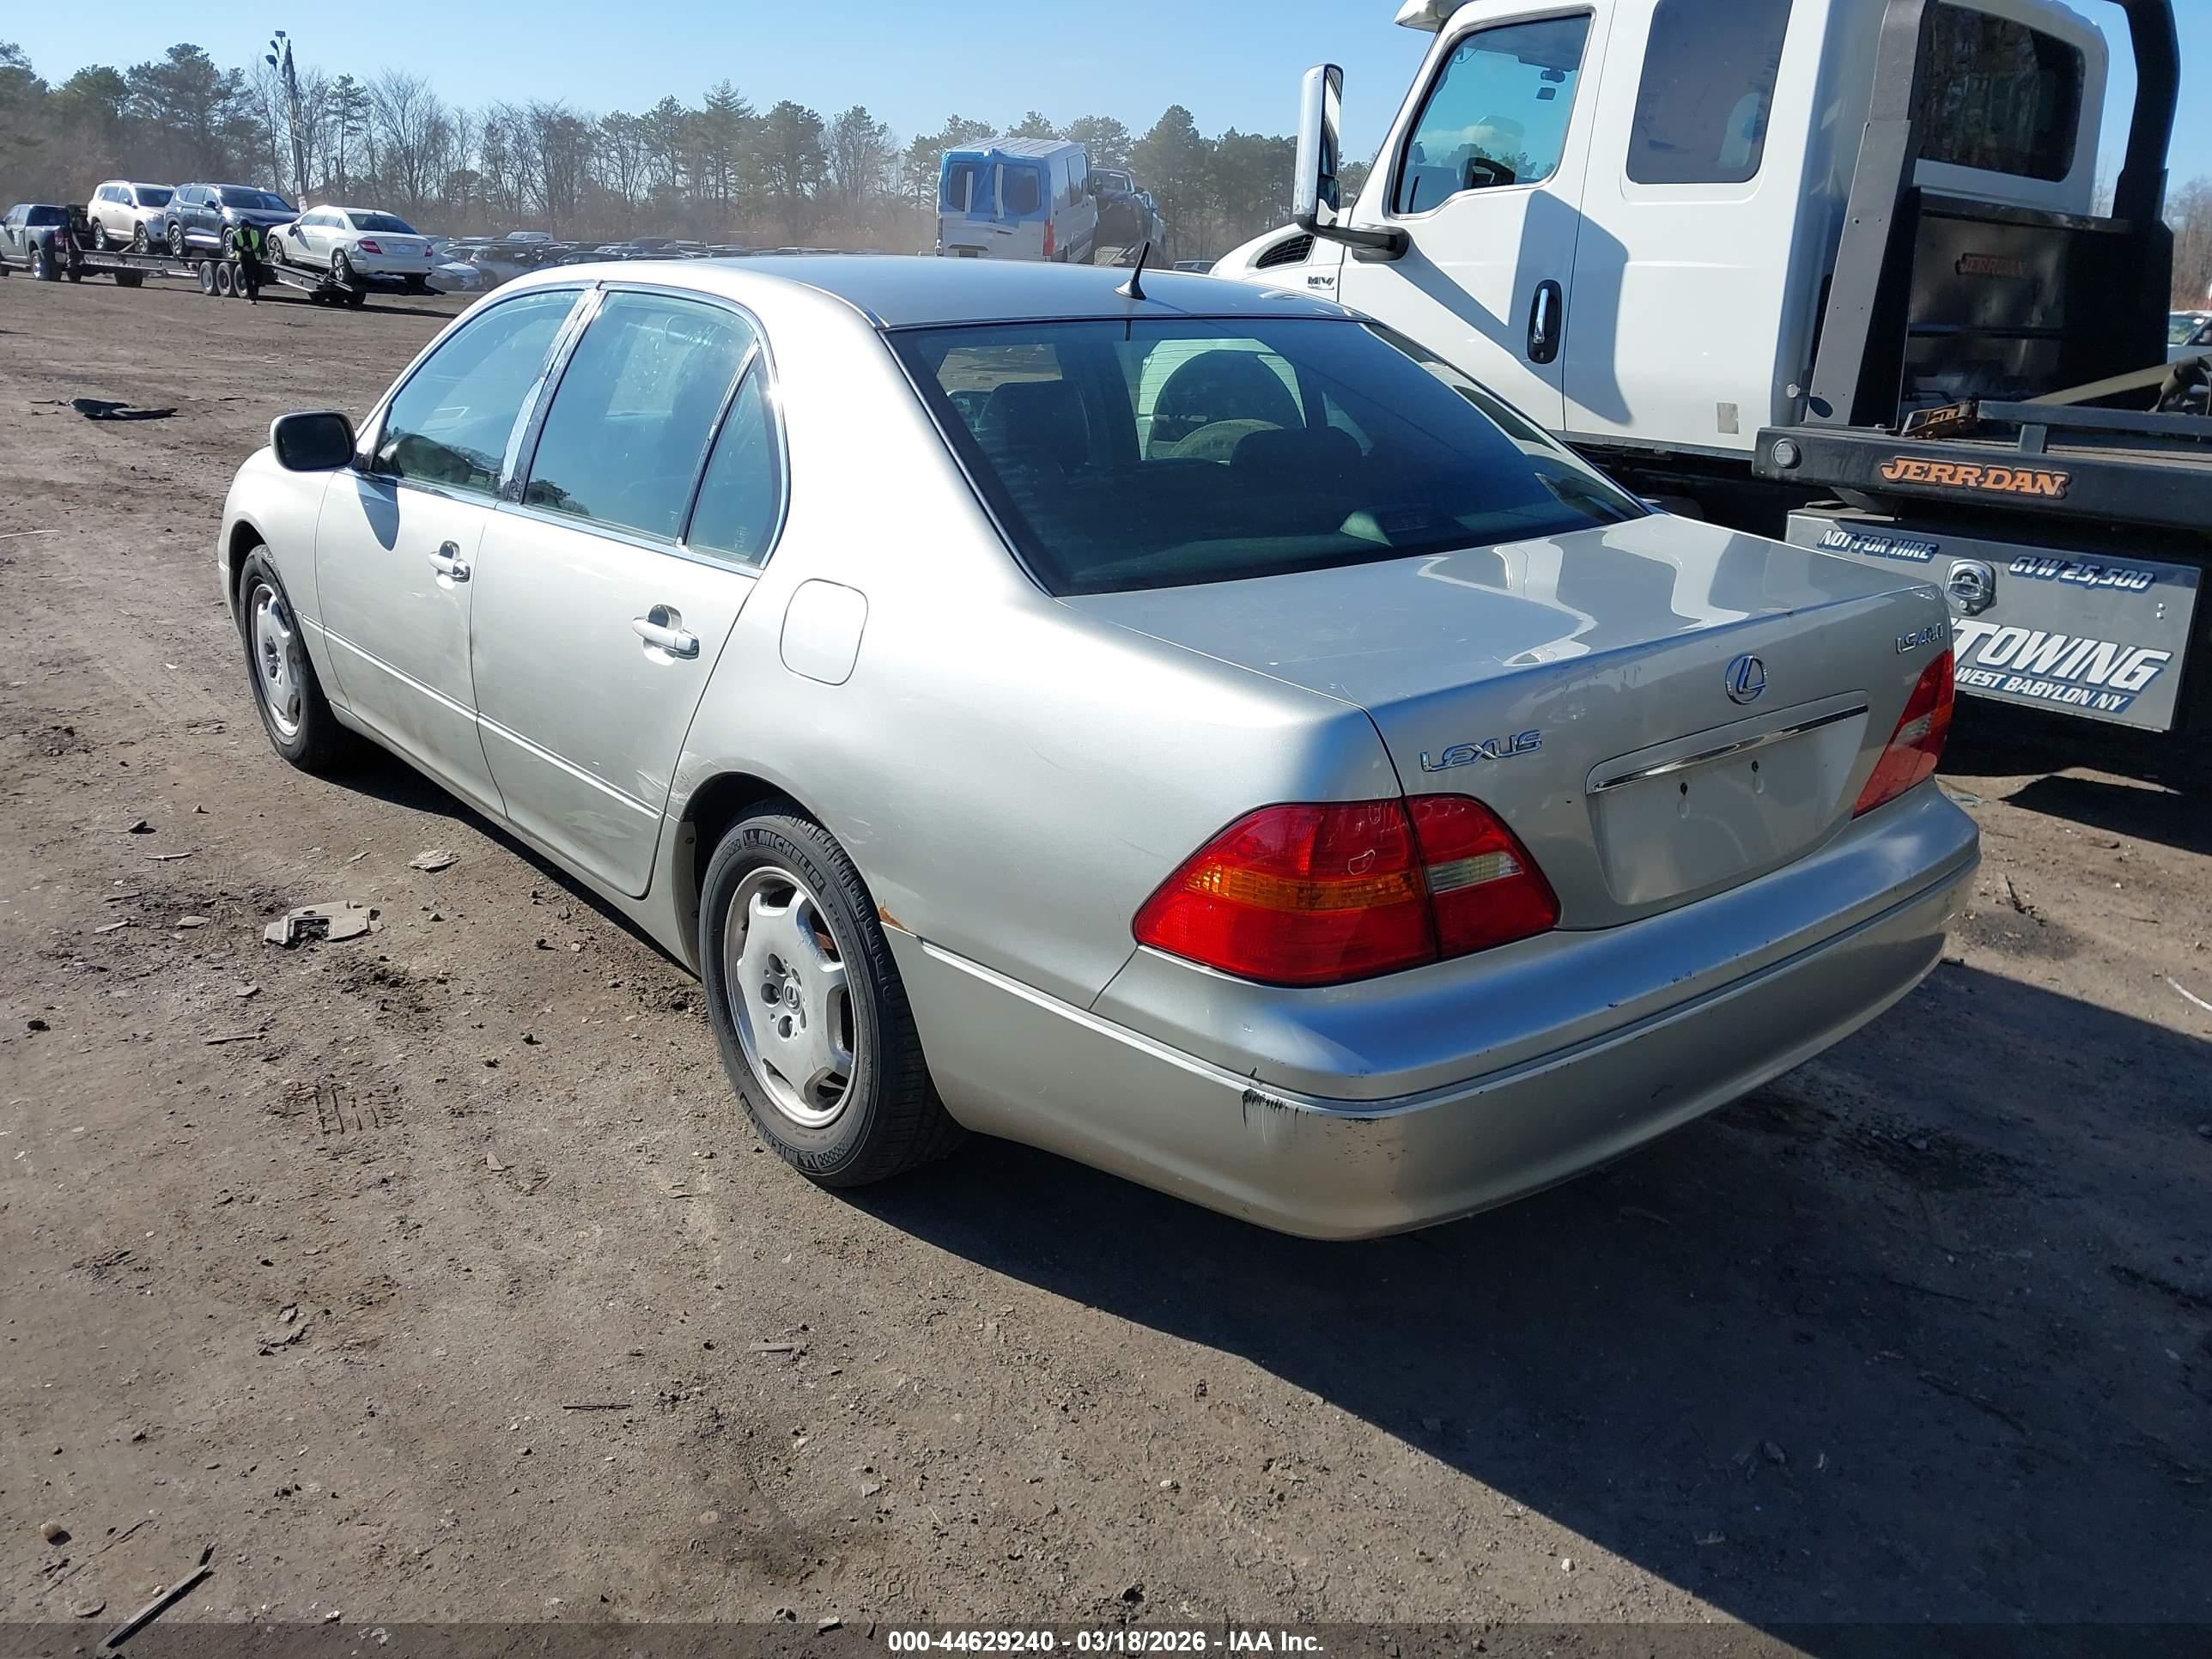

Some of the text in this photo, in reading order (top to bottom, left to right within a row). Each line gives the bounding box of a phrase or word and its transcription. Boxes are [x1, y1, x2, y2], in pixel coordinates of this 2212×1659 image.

[1881, 458, 2069, 497] JERR-DAN
[1820, 530, 1937, 560] NOT FOR HIRE
[2008, 556, 2154, 590] GVW 25,500
[1951, 618, 2172, 693] TOWING
[1955, 666, 2129, 712] WEST BABYLON NY
[1419, 728, 1542, 773] LEXUS
[758, 830, 826, 891] MICHELIN
